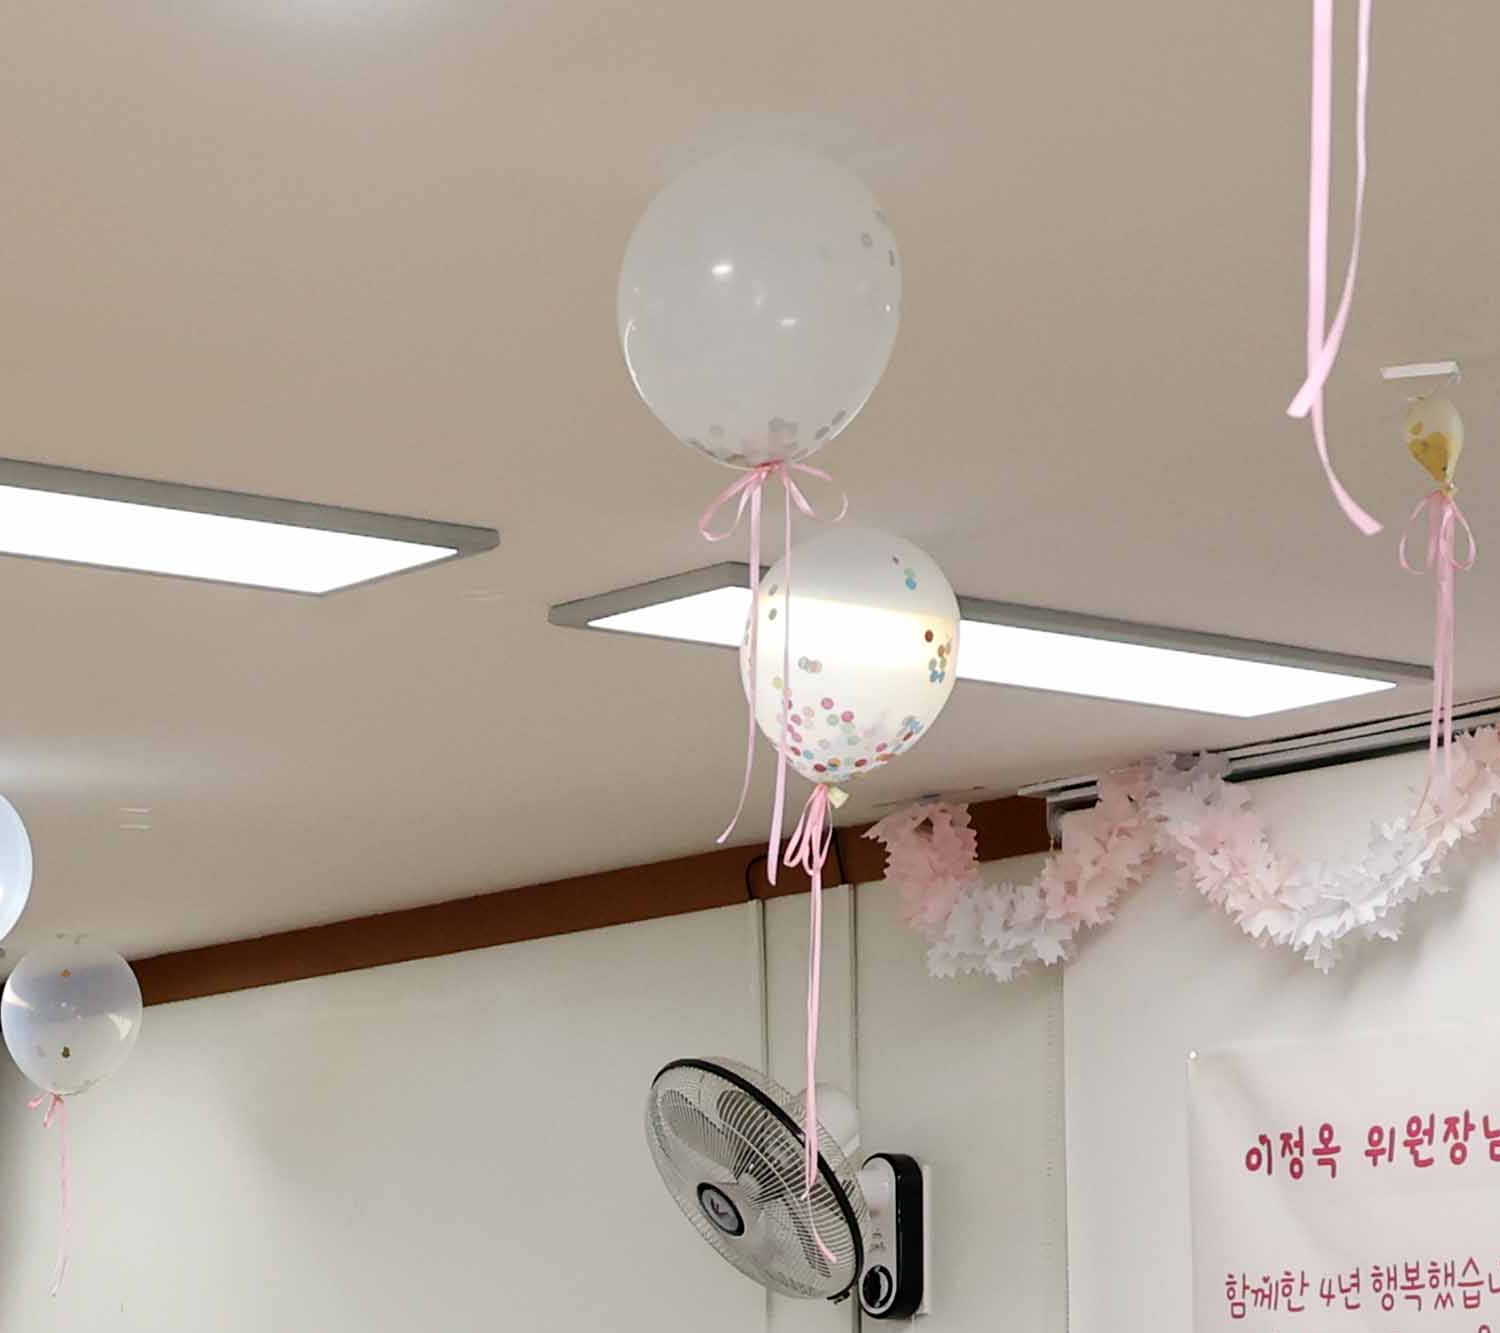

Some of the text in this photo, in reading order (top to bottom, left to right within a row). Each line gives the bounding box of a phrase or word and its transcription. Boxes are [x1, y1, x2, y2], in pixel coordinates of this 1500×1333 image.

[1245, 1123, 1341, 1180] 이정옥
[1225, 1264, 1310, 1319] 함께한
[1319, 1267, 1361, 1310] 4년
